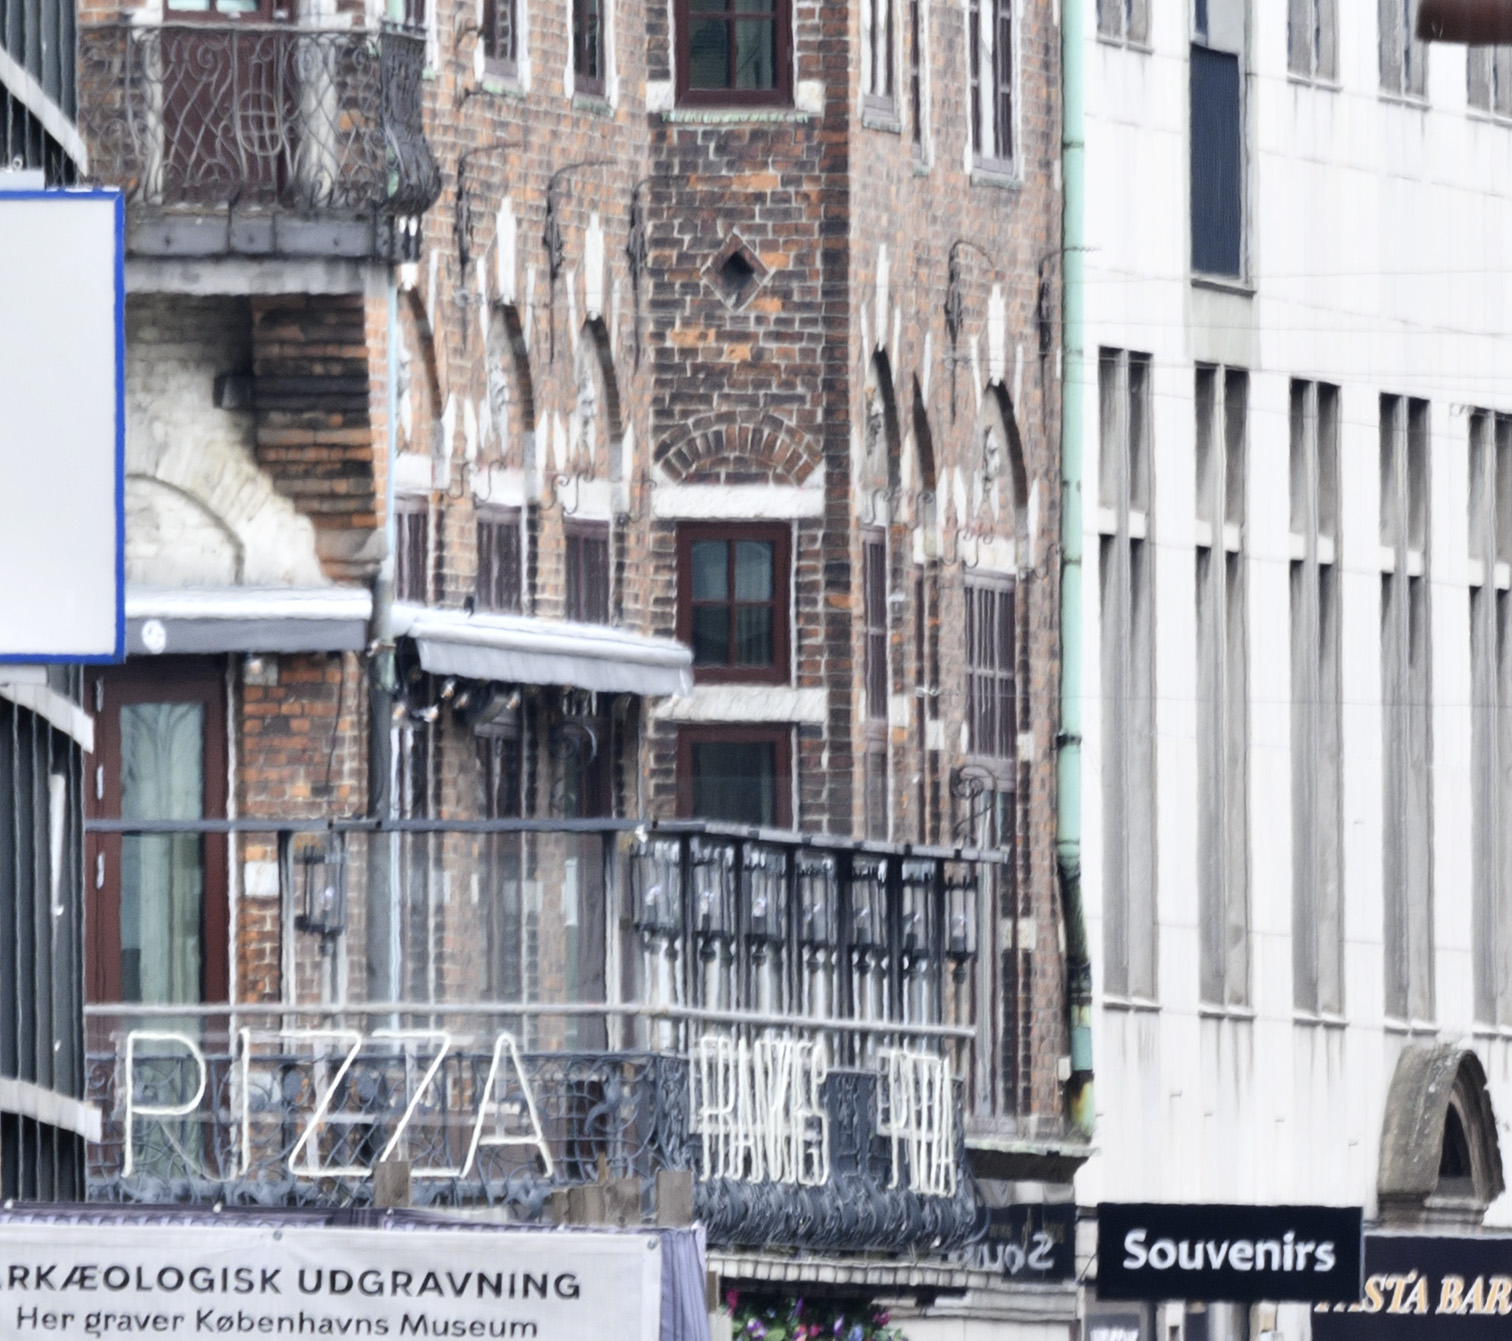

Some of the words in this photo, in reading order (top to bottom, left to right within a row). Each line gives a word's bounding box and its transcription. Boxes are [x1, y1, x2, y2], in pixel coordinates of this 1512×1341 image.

[122, 1028, 553, 1178] PIZZA
[1122, 1228, 1337, 1272] Souvenirs
[297, 1269, 583, 1301] UDGRAVNING
[16, 1306, 76, 1332] Her
[84, 1311, 186, 1340] graver
[195, 1308, 390, 1336] Københavns
[399, 1314, 539, 1340] Museum
